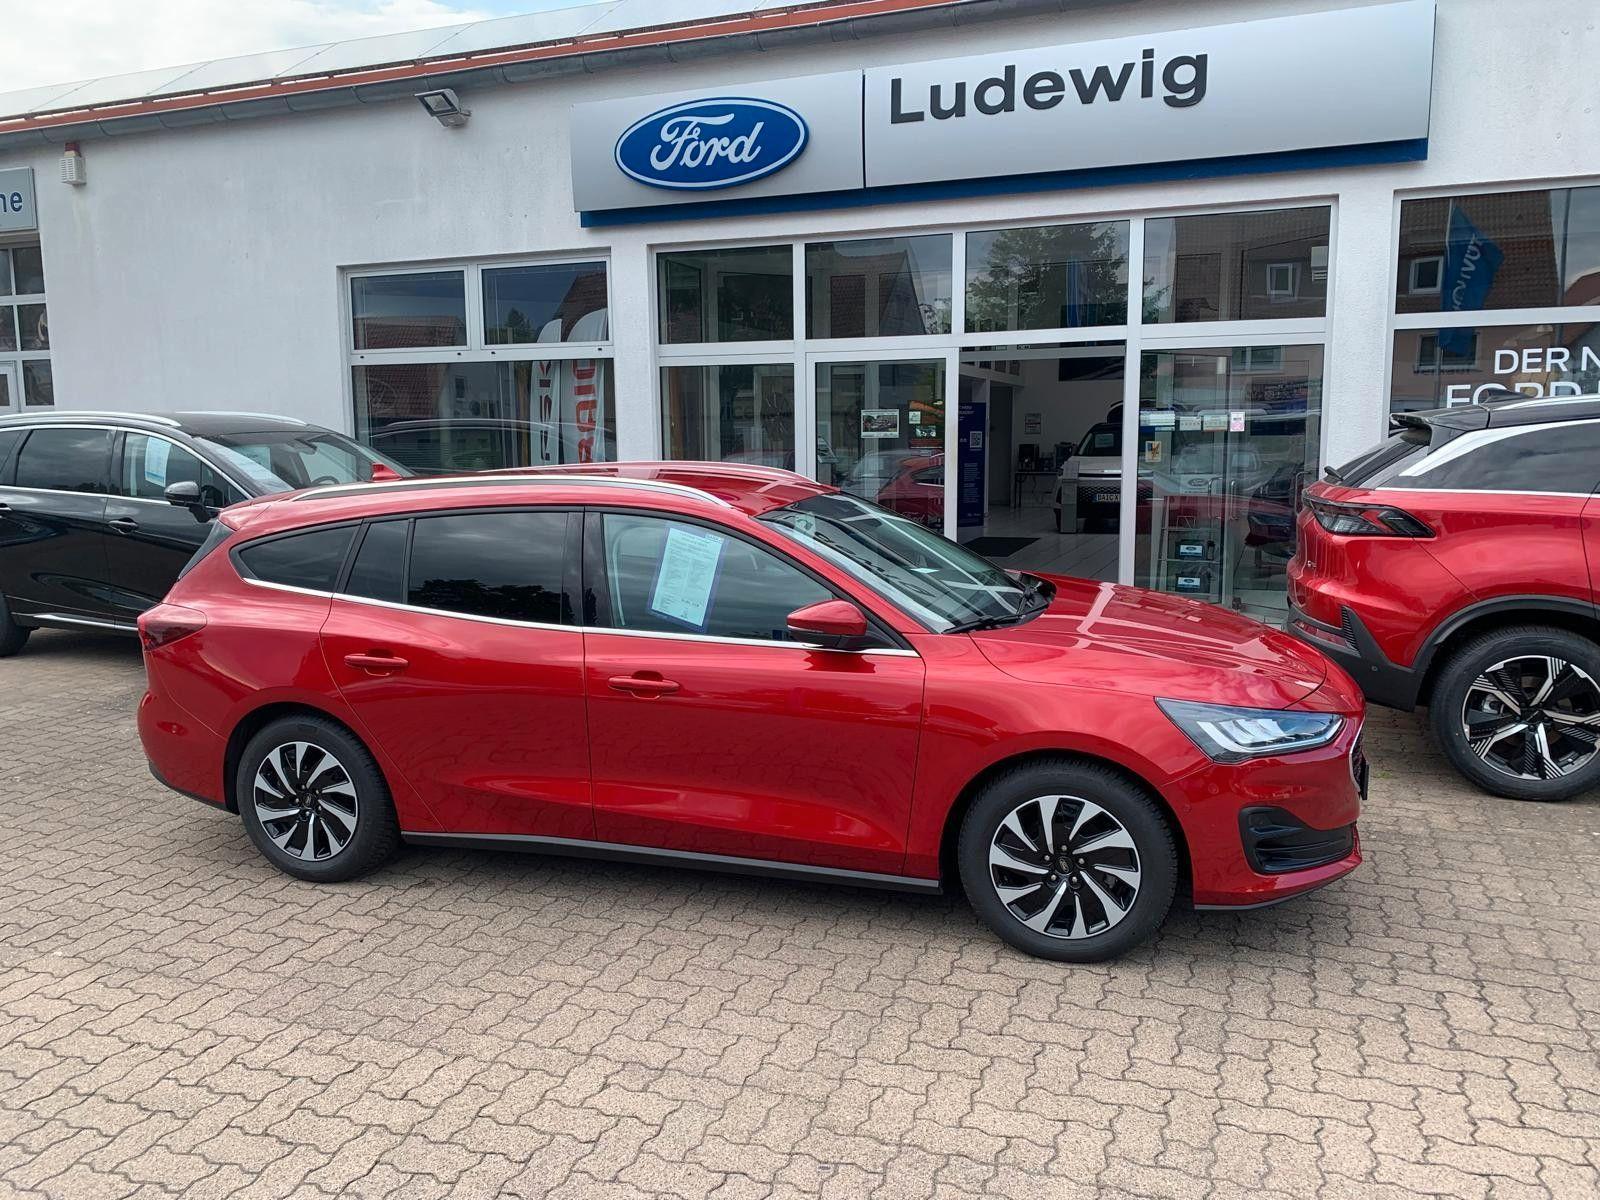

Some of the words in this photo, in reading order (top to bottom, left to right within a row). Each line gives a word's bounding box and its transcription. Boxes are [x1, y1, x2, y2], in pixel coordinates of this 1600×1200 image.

[890, 48, 1208, 124] Ludewig
[650, 113, 764, 170] Ford
[1494, 347, 1570, 374] DER
